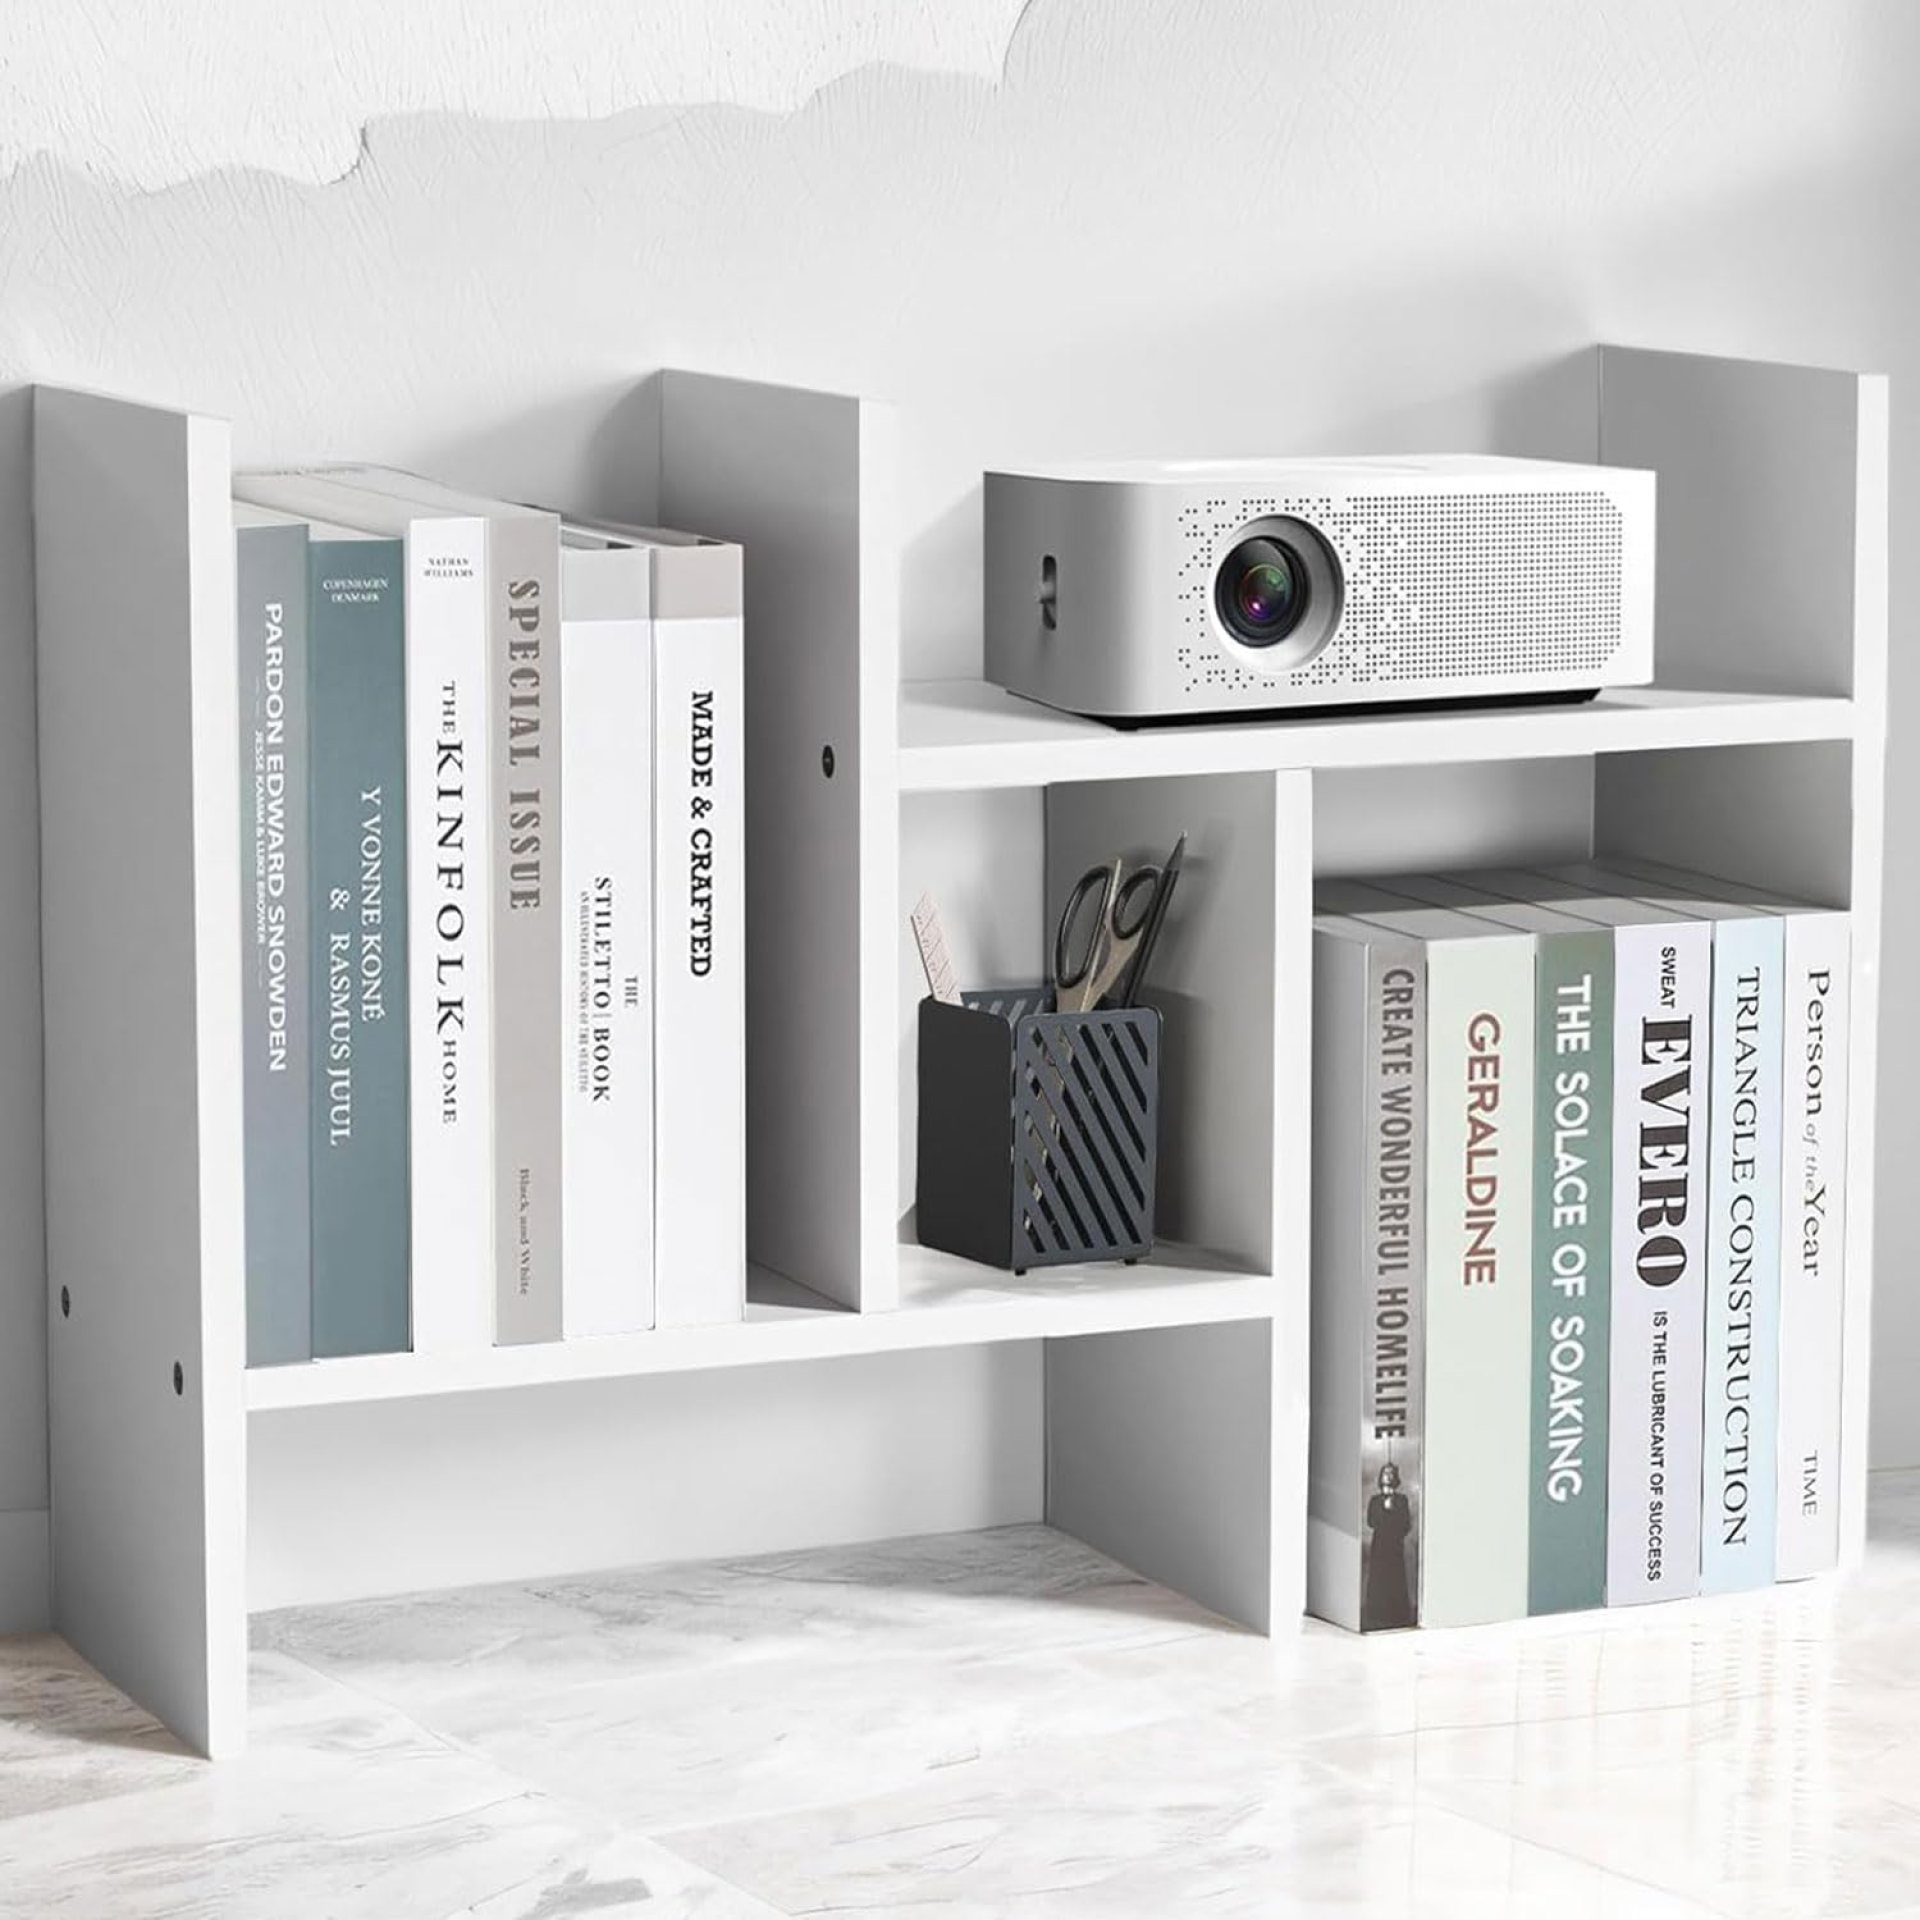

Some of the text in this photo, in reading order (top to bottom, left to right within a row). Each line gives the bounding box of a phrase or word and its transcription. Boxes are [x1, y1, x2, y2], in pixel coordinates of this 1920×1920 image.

[265, 603, 286, 1071] PARDON EDWARD SNOWDEN
[507, 579, 541, 911] SPECIAL ISSUE
[690, 691, 714, 978] MADE & CRAFTED
[327, 887, 352, 1146] & RASMUS JUUL
[361, 933, 387, 1022] KONÉ
[436, 681, 465, 1122] THE KINFOLK HOME
[593, 877, 612, 1102] STILETTO BOOK
[624, 975, 639, 1007] THE
[519, 1168, 530, 1212] Black
[1374, 969, 1415, 1441] CREATE WONDERFUL HOMELIFE
[1464, 1013, 1500, 1286] GERALDINE
[1547, 974, 1591, 1502] THE SOLACE OF SOAKING
[1636, 946, 1693, 1582] SWEAT EVERO IS THE LUBRICANT OF SUCCESS
[1723, 966, 1761, 1545] TRIANGLE CONSTRUCTION
[1802, 969, 1830, 1278] Person of the Year
[519, 1248, 530, 1295] White
[1802, 1450, 1818, 1514] TIME
